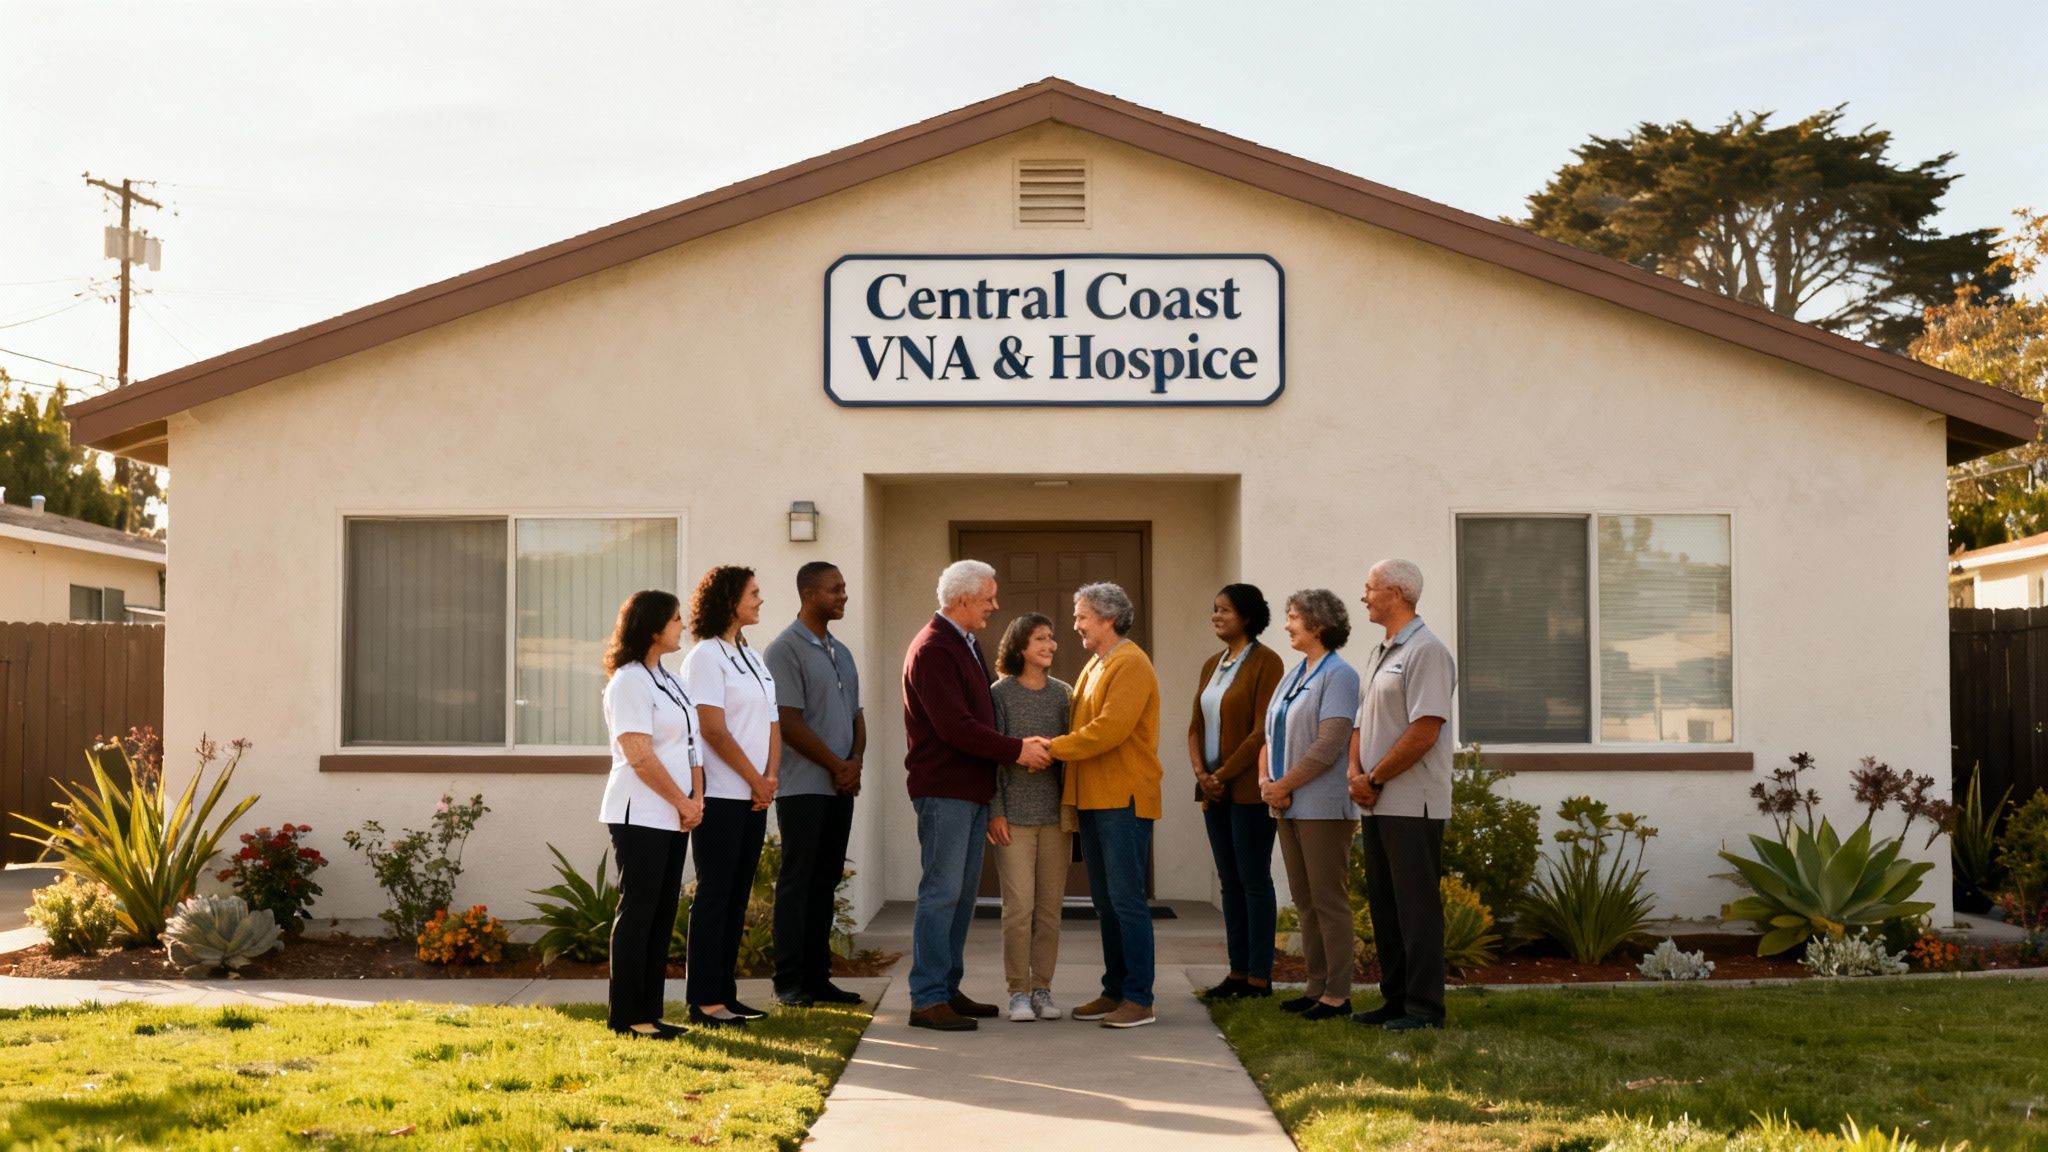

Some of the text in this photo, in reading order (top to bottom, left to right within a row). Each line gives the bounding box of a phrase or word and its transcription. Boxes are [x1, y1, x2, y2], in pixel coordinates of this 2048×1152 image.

[866, 269, 1242, 320] Central Coast
[851, 333, 1258, 394] VNA & Hospice
